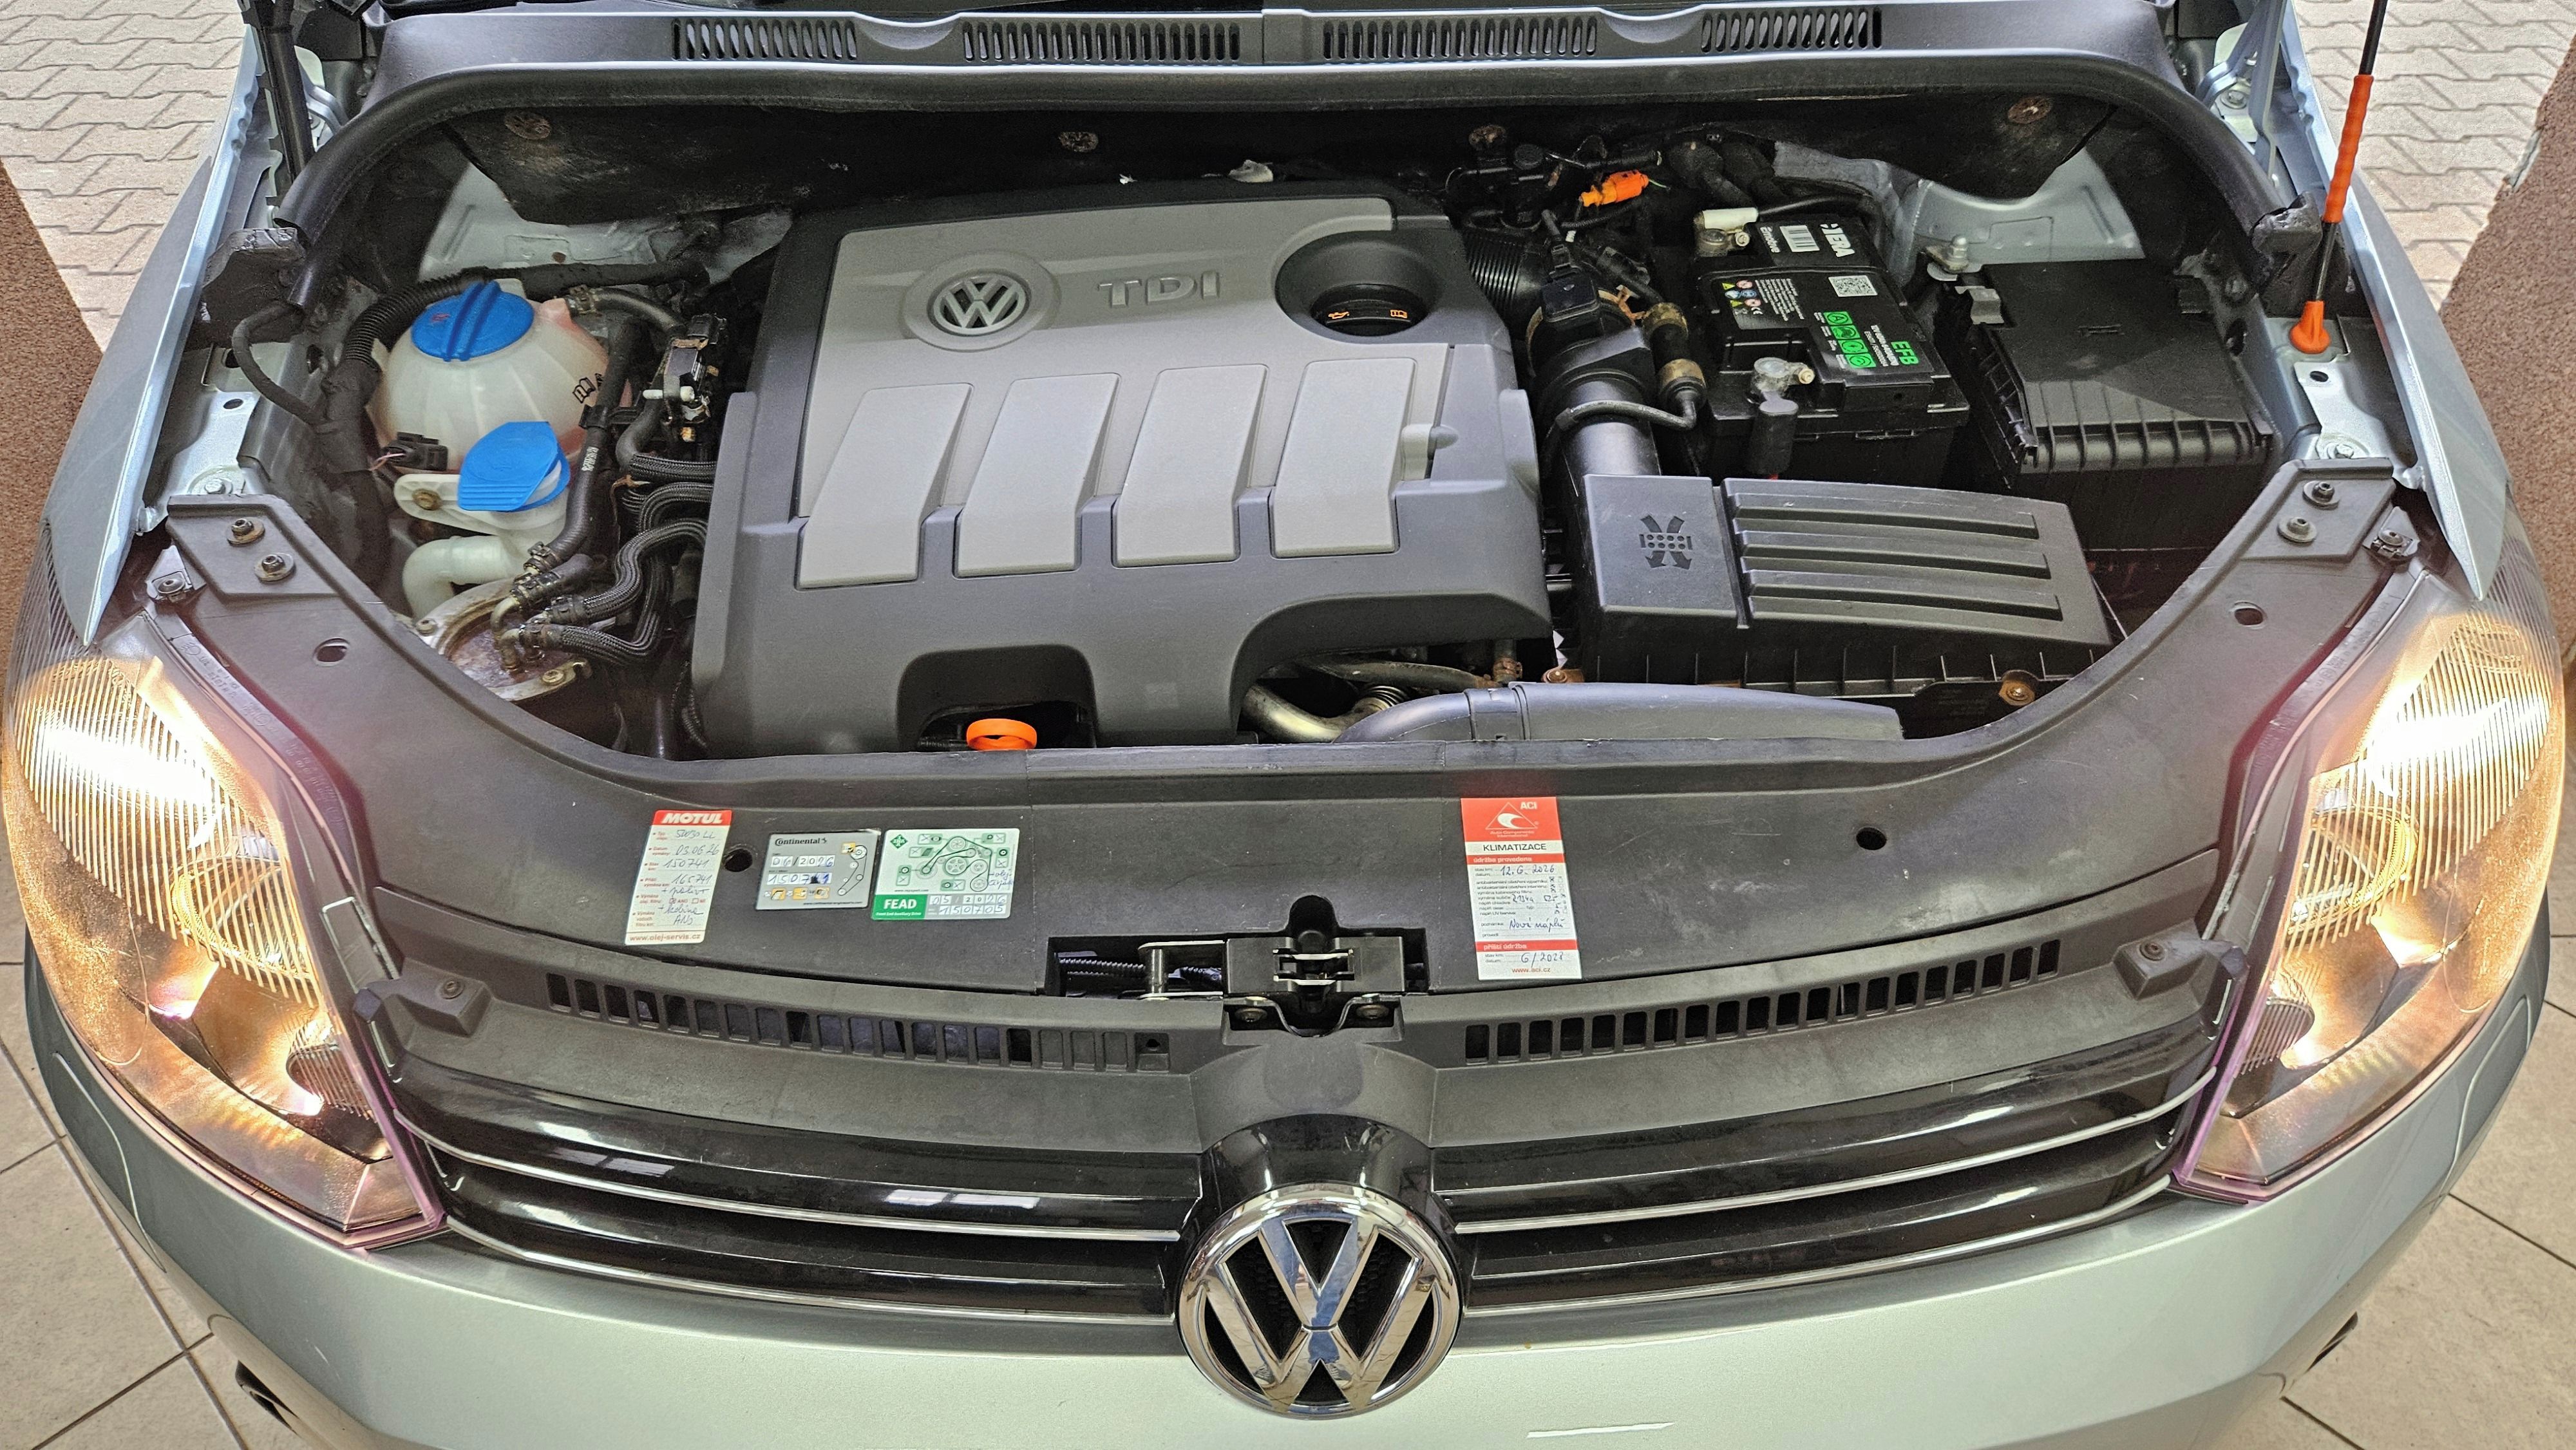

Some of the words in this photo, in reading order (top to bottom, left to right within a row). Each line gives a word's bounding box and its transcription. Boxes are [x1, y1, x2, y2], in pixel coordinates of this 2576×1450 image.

[1097, 270, 1221, 307] TDI
[1891, 341, 1919, 364] EFB
[661, 812, 723, 824] MOTUL
[775, 838, 820, 846] Continental
[663, 858, 710, 869] 150741
[1533, 864, 1555, 873] 2026
[884, 898, 917, 909] FEAD
[629, 934, 701, 942] www.olej-servis.cz
